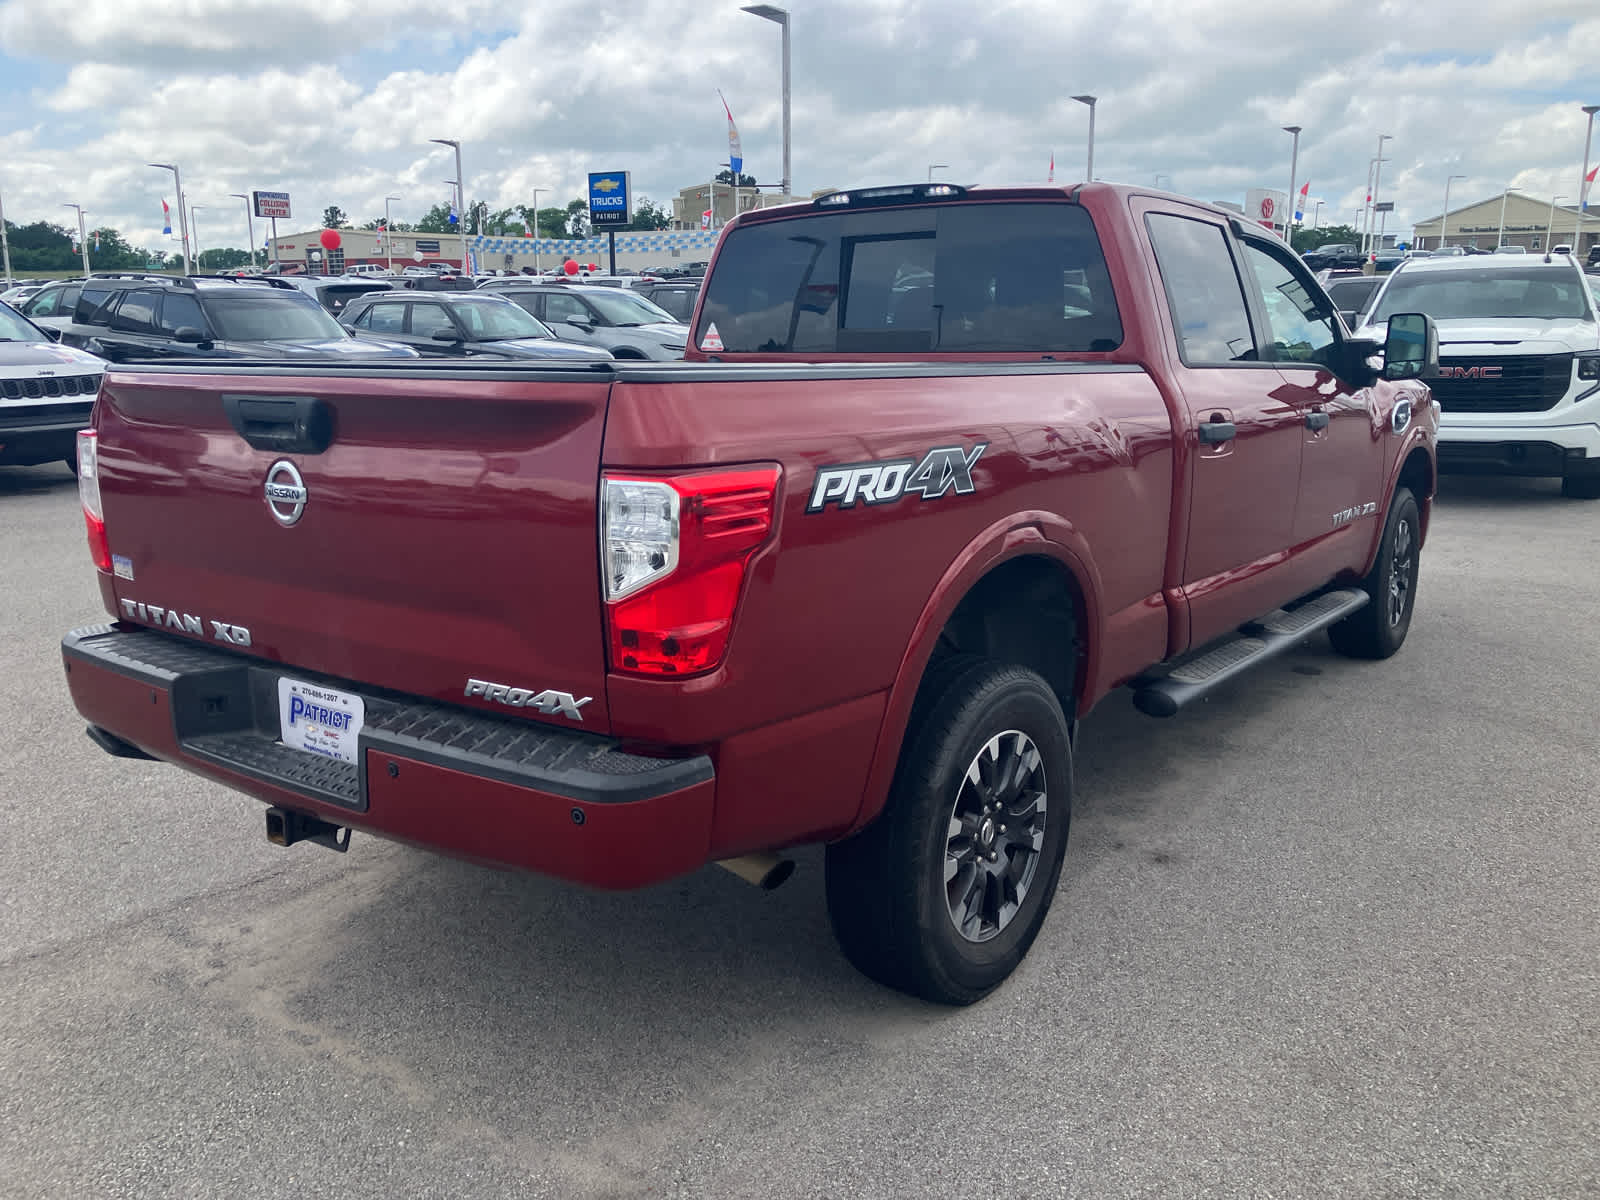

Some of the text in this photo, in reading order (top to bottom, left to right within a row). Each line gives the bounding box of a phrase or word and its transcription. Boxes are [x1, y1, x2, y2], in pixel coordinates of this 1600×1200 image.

[260, 199, 289, 208] COLLISION
[591, 196, 624, 206] TRUCKS
[264, 208, 286, 216] CENTER
[596, 212, 620, 220] PATRIOT
[266, 487, 300, 500] NISSAN
[1332, 506, 1361, 527] TITAN
[120, 598, 252, 647] TITAN XD
[290, 695, 353, 731] PATRIOT
